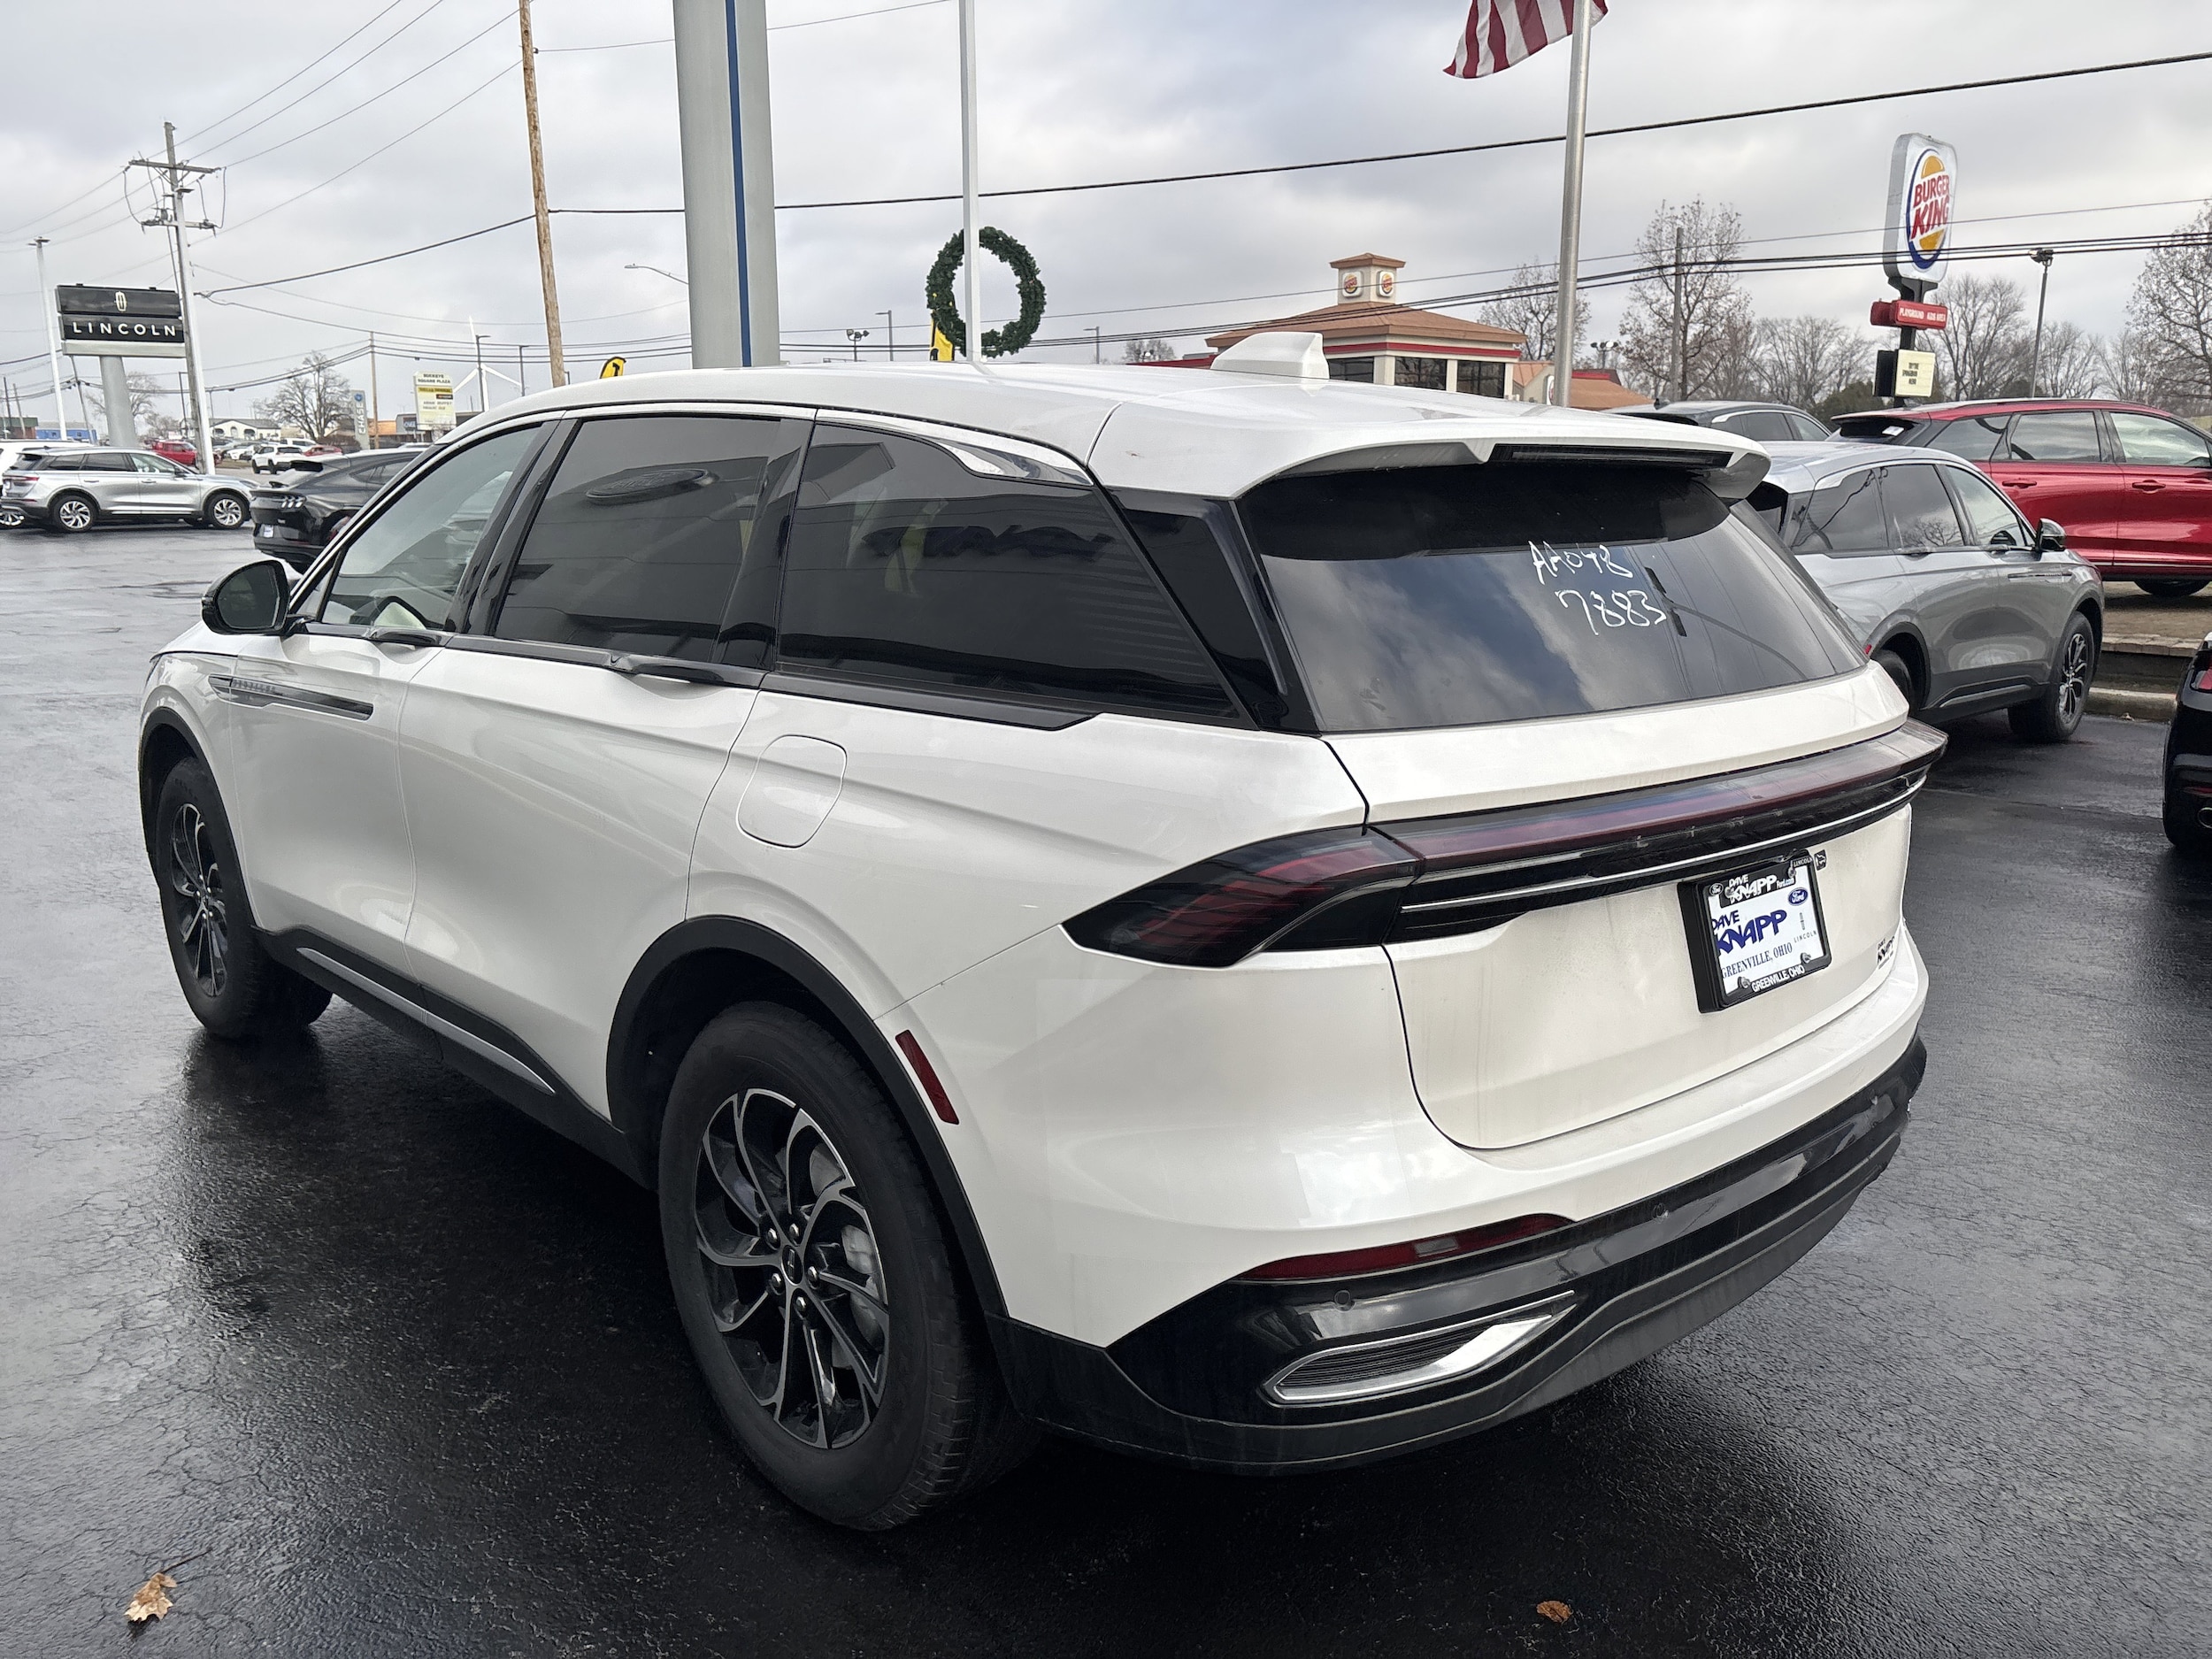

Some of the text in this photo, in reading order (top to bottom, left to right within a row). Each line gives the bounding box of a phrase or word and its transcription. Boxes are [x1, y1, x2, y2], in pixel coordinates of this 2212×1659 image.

[1913, 175, 1950, 208] BURGER
[1911, 195, 1950, 240] KING
[73, 321, 176, 336] LINCOLN
[357, 403, 366, 434] CHASE
[1555, 590, 1667, 635] 7883
[1728, 874, 1749, 887] DAVE
[1728, 874, 1778, 904] KNAPP
[1711, 910, 1740, 931] DAVE
[1716, 910, 1787, 954] KNAPP
[1793, 930, 1817, 943] LINCOLN
[1721, 941, 1793, 979] GREENVILLE, OHIO
[1789, 964, 1805, 978] OHIO
